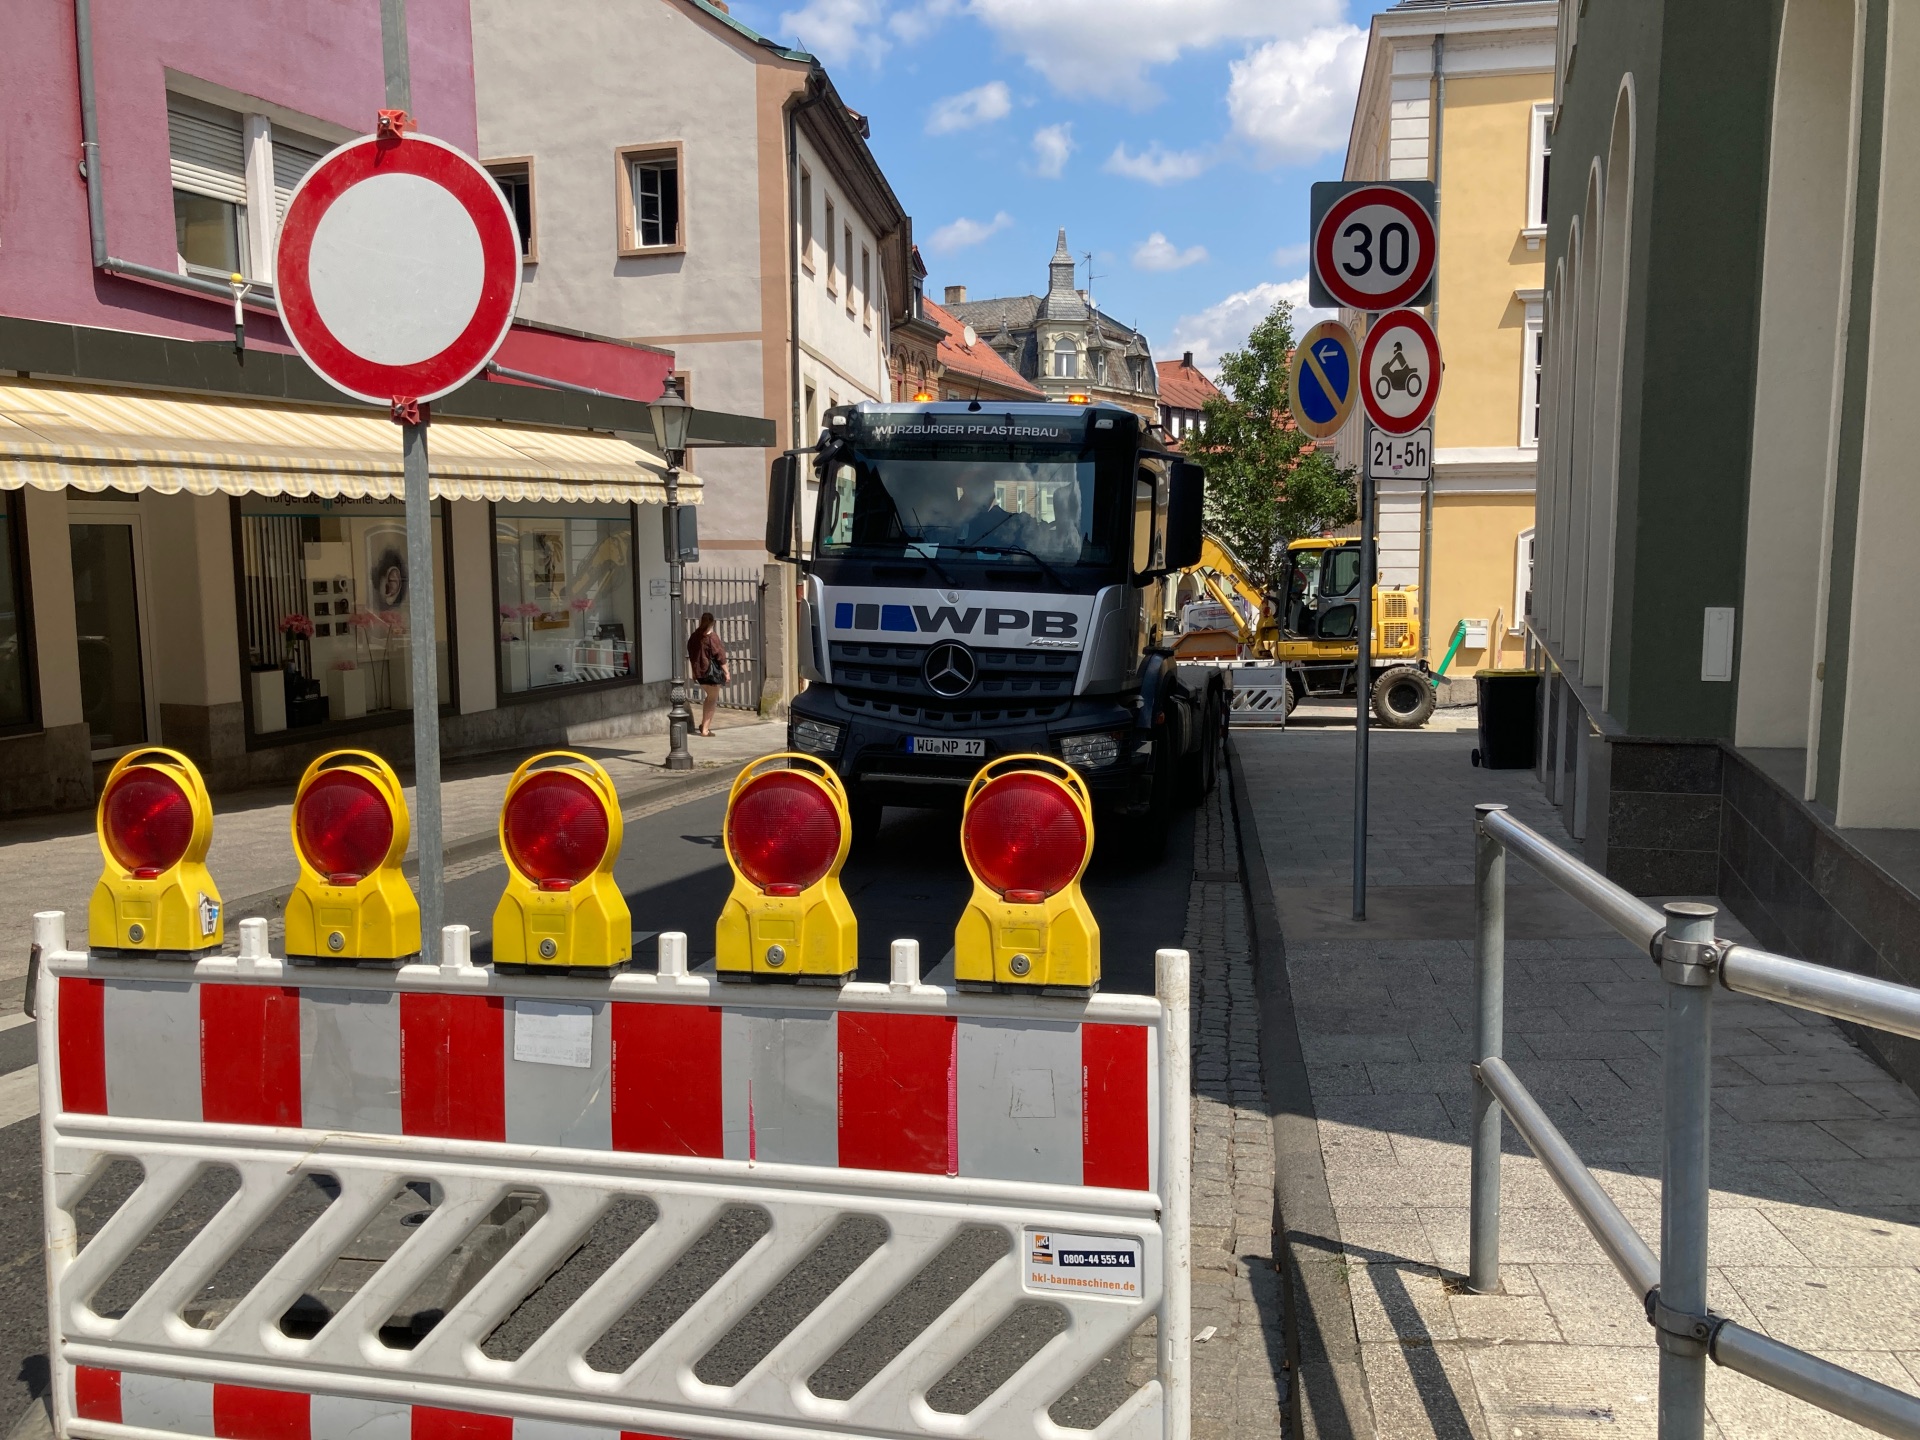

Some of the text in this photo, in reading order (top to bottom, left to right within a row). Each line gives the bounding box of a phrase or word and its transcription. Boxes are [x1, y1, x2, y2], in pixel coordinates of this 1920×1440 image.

[1342, 222, 1410, 277] 30
[875, 423, 1059, 438] WÜRZBURGER PFLASTERBAU
[1373, 441, 1426, 467] 21-5h
[911, 605, 1078, 639] WPB
[916, 739, 981, 755] WÜ NP 17
[1063, 1254, 1099, 1264] 0800-44
[1101, 1254, 1117, 1265] 555
[1118, 1254, 1130, 1265] 44
[1032, 1272, 1135, 1291] hkl-baumaschinen.de
